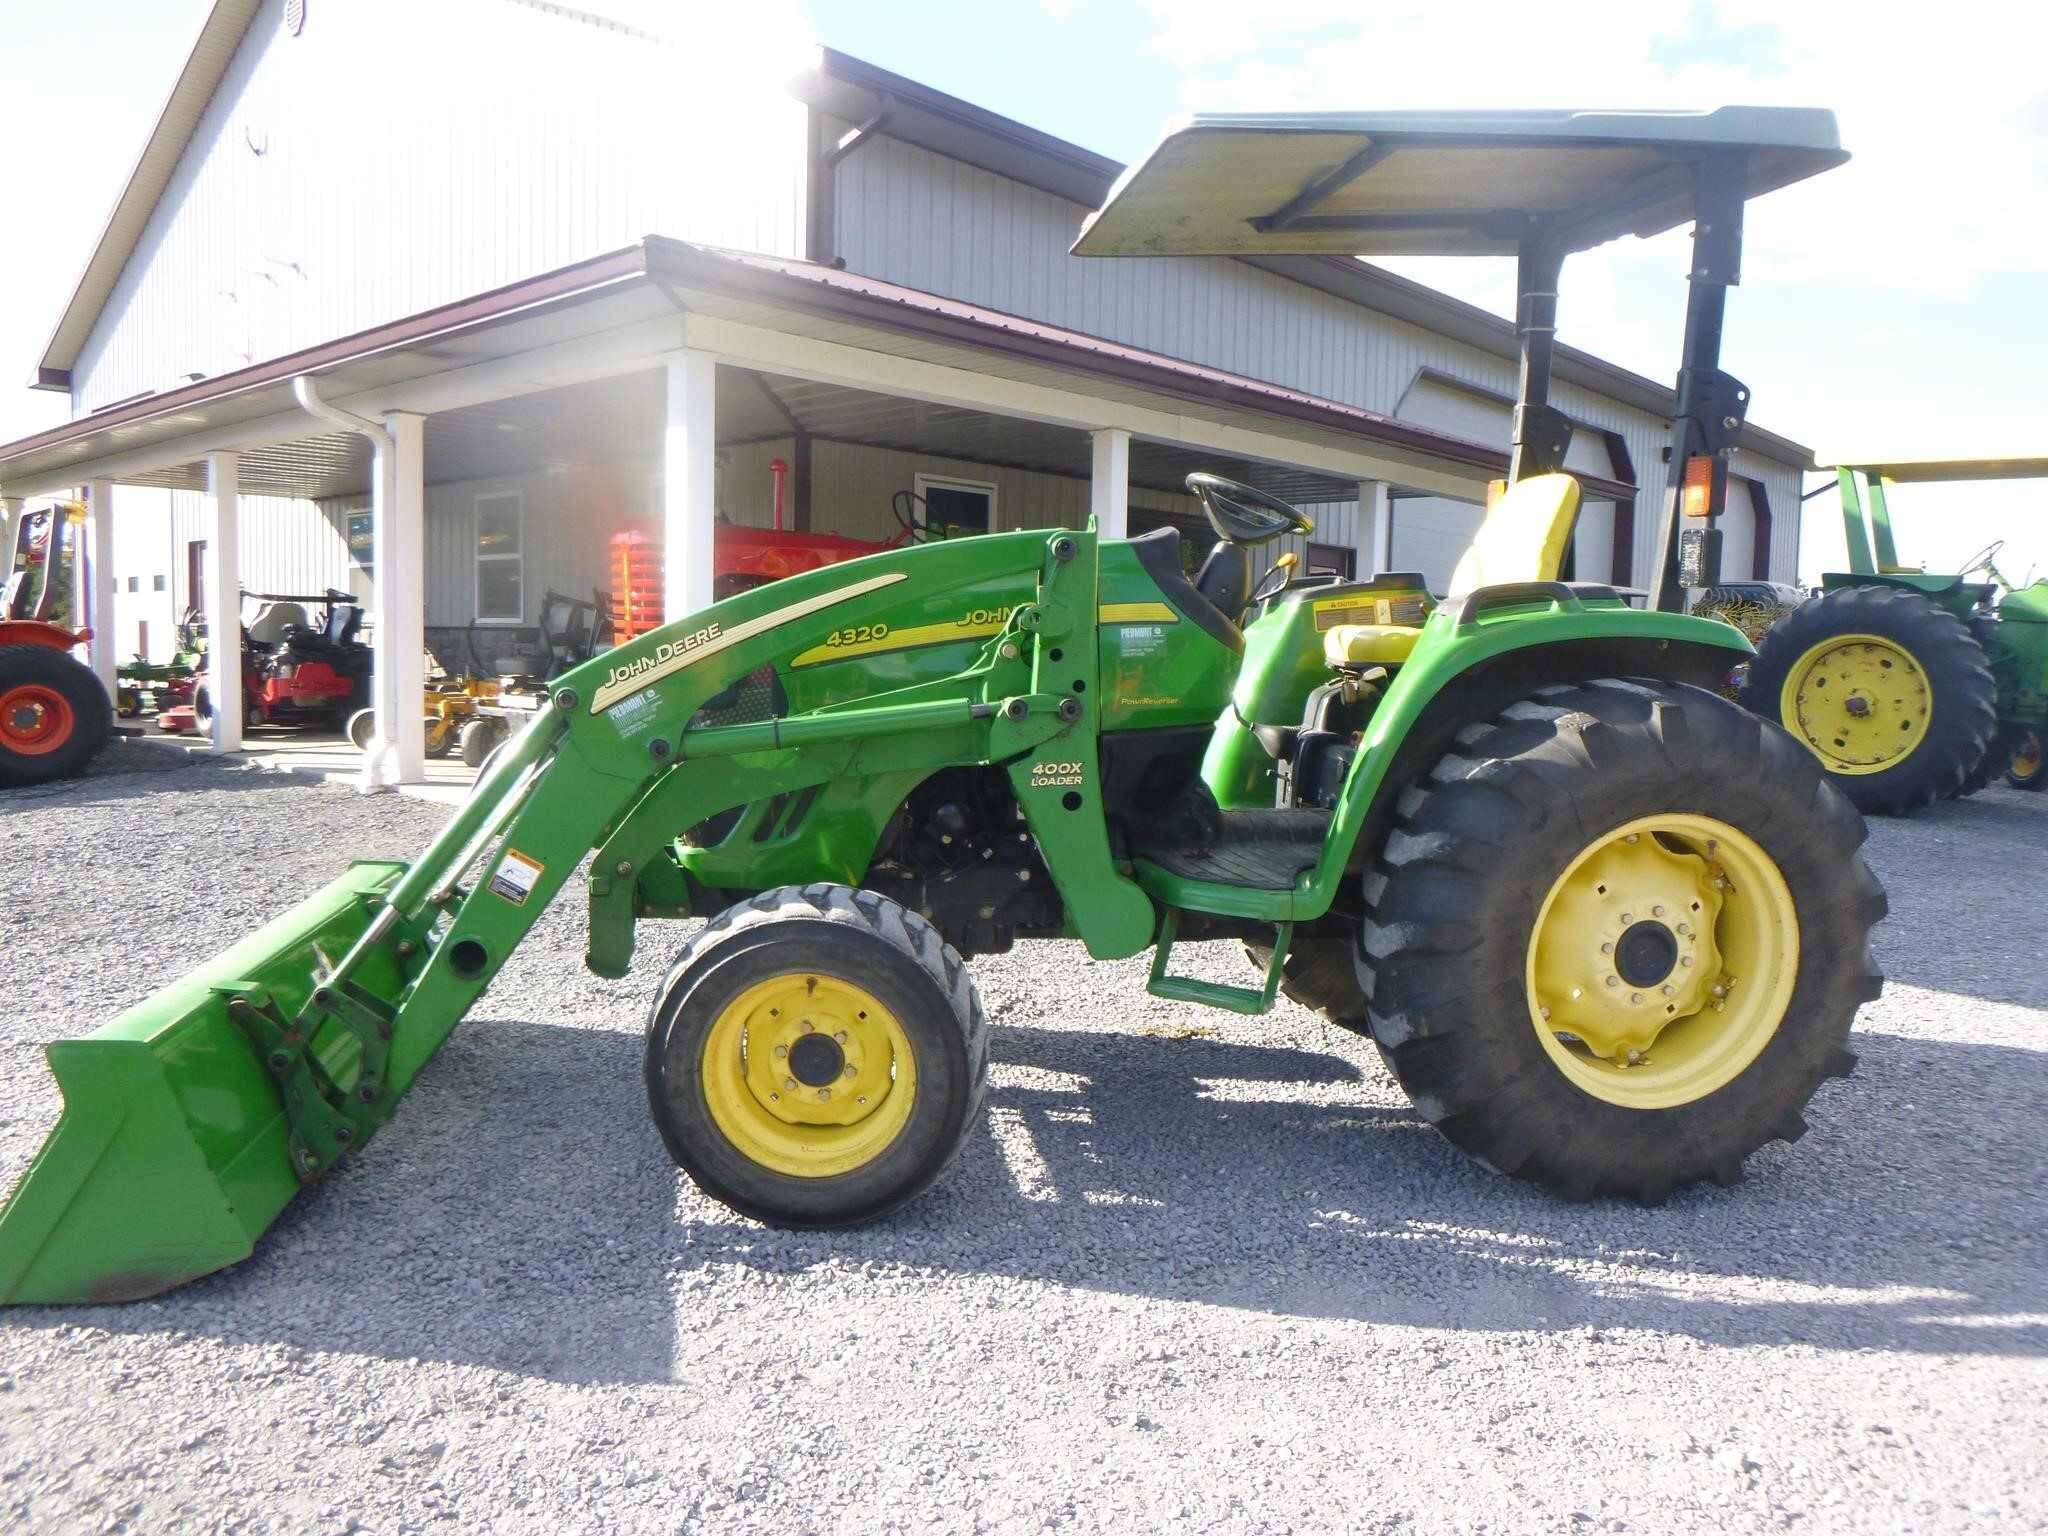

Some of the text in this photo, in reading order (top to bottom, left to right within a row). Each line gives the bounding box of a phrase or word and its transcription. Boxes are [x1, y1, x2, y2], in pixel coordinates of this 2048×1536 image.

[826, 623, 889, 647] 4320
[605, 622, 723, 688] JOHN DEERE
[608, 693, 647, 720] PIEDMONT
[1121, 697, 1180, 705] PowrReverser
[1032, 762, 1083, 775] 400X
[1031, 776, 1083, 787] LOADER
